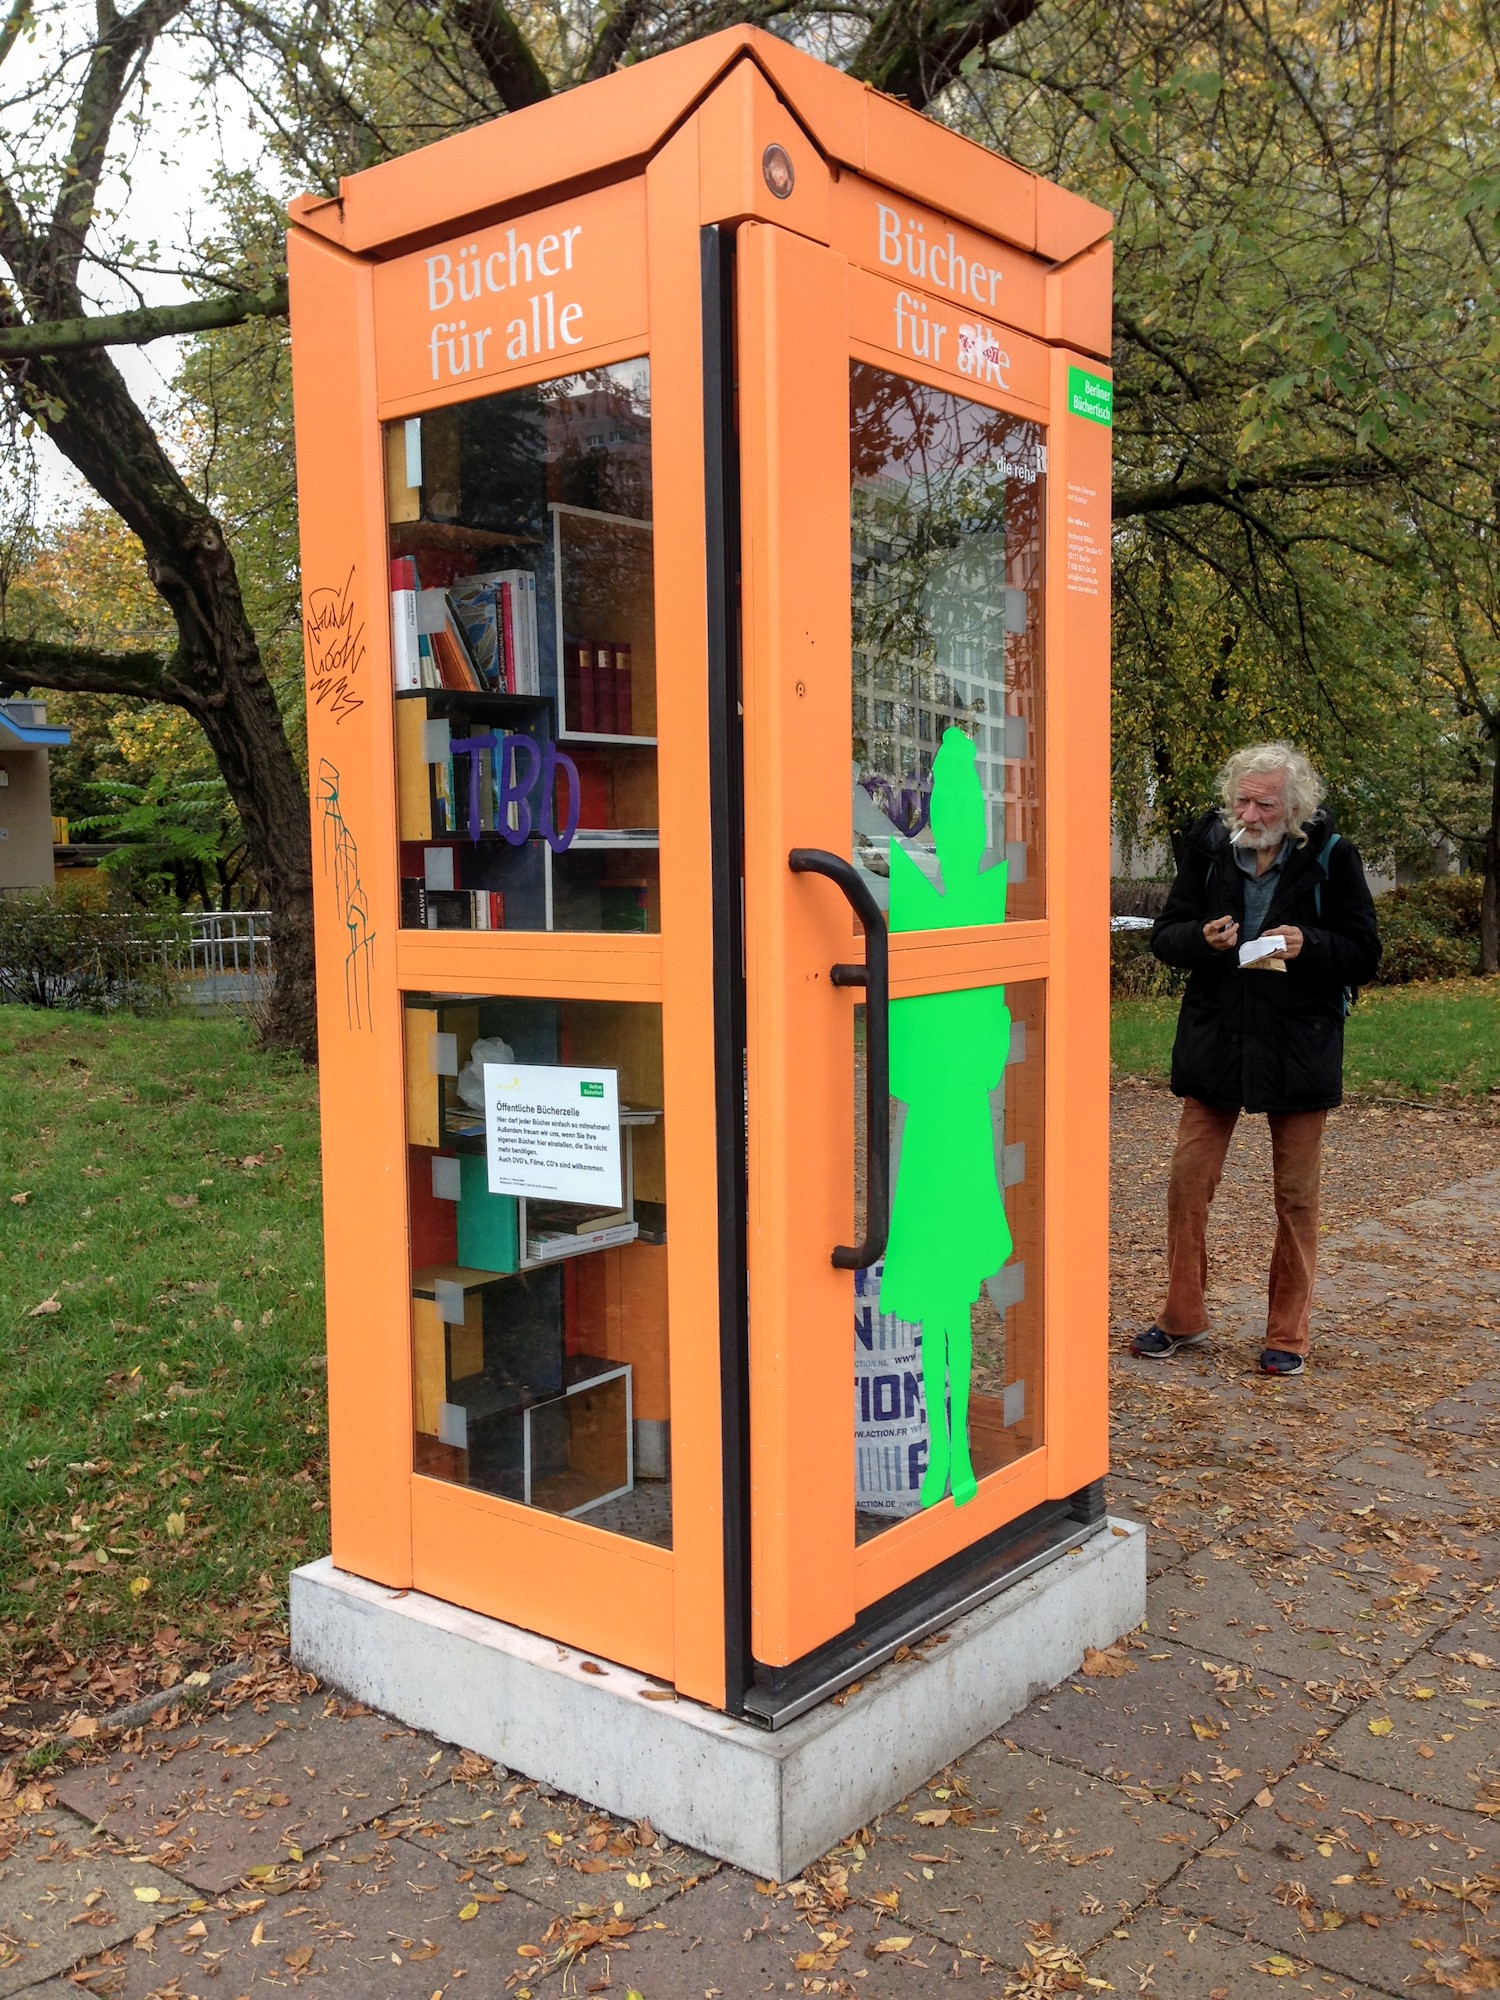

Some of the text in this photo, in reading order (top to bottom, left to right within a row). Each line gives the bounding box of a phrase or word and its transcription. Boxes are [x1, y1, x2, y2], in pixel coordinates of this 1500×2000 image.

[876, 202, 1003, 306] Bücher
[424, 225, 582, 311] Bücher
[428, 291, 584, 381] für alle
[893, 291, 947, 362] für
[1085, 380, 1111, 402] Berliner
[1073, 394, 1111, 421] Büchertisch
[997, 455, 1037, 483] die reha
[498, 633, 506, 674] ABORIGINAL
[496, 1100, 580, 1117] Öffentliche Bücherzelle
[497, 1126, 522, 1134] Außerdem
[523, 1128, 539, 1136] freuen
[551, 1120, 570, 1128] einfach
[579, 1123, 610, 1131] mitnehmen!
[497, 1136, 517, 1144] eigenen
[518, 1137, 536, 1146] Bücher
[547, 1140, 574, 1149] einstellen,
[593, 1144, 608, 1152] nicht
[530, 1158, 546, 1167] Filme,
[572, 1163, 605, 1172] willkommen.
[855, 1371, 926, 1421] ION
